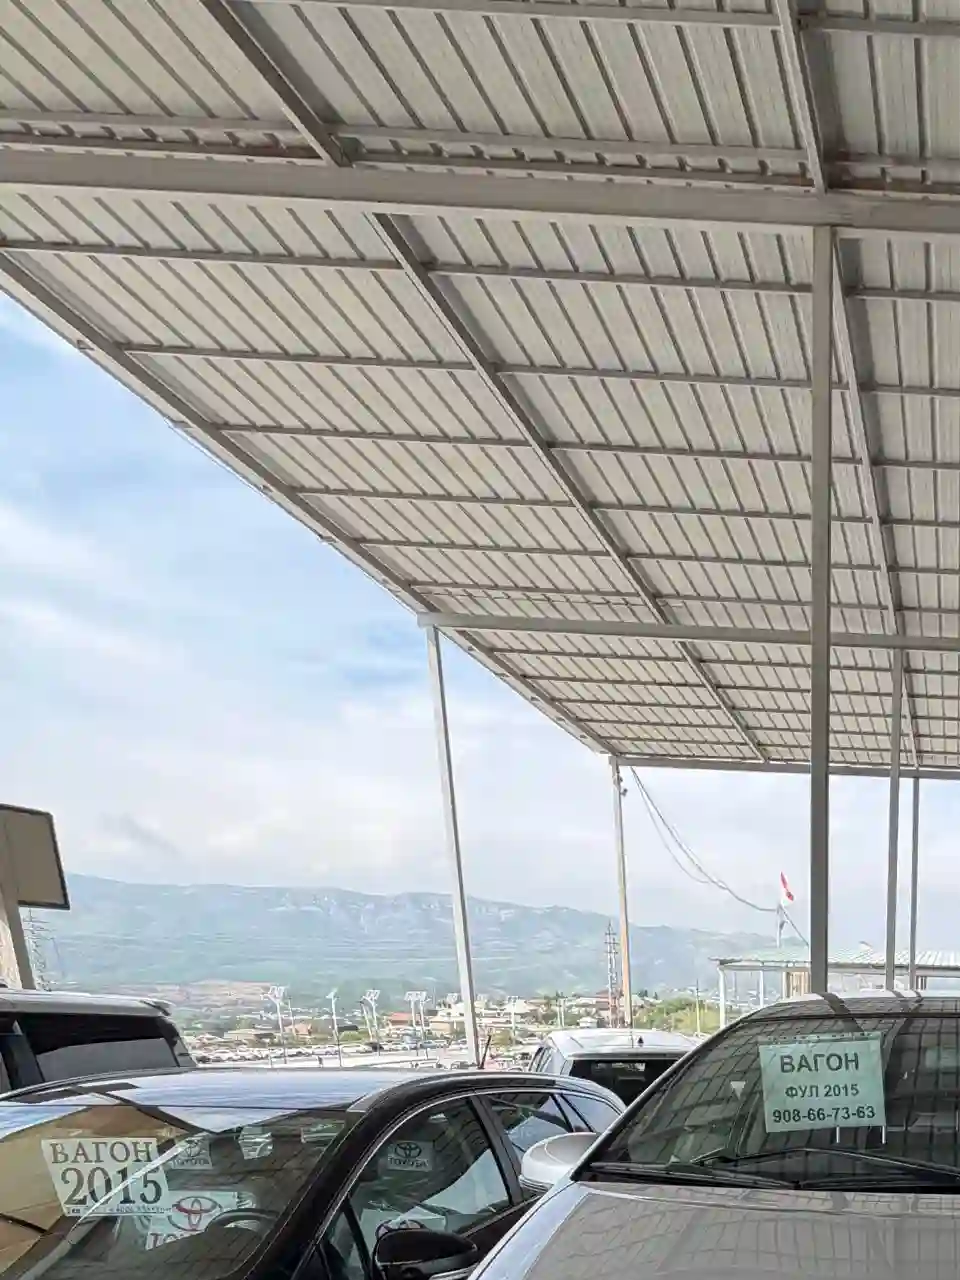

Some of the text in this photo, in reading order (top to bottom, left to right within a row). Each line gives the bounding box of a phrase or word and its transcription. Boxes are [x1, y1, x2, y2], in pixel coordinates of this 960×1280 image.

[780, 1052, 859, 1073] ВАГОН
[785, 1083, 859, 1098] ФУЛ 2015
[772, 1105, 876, 1123] 908-66-73-63
[50, 1141, 153, 1164] ВАГОН
[60, 1166, 163, 1206] 2015
